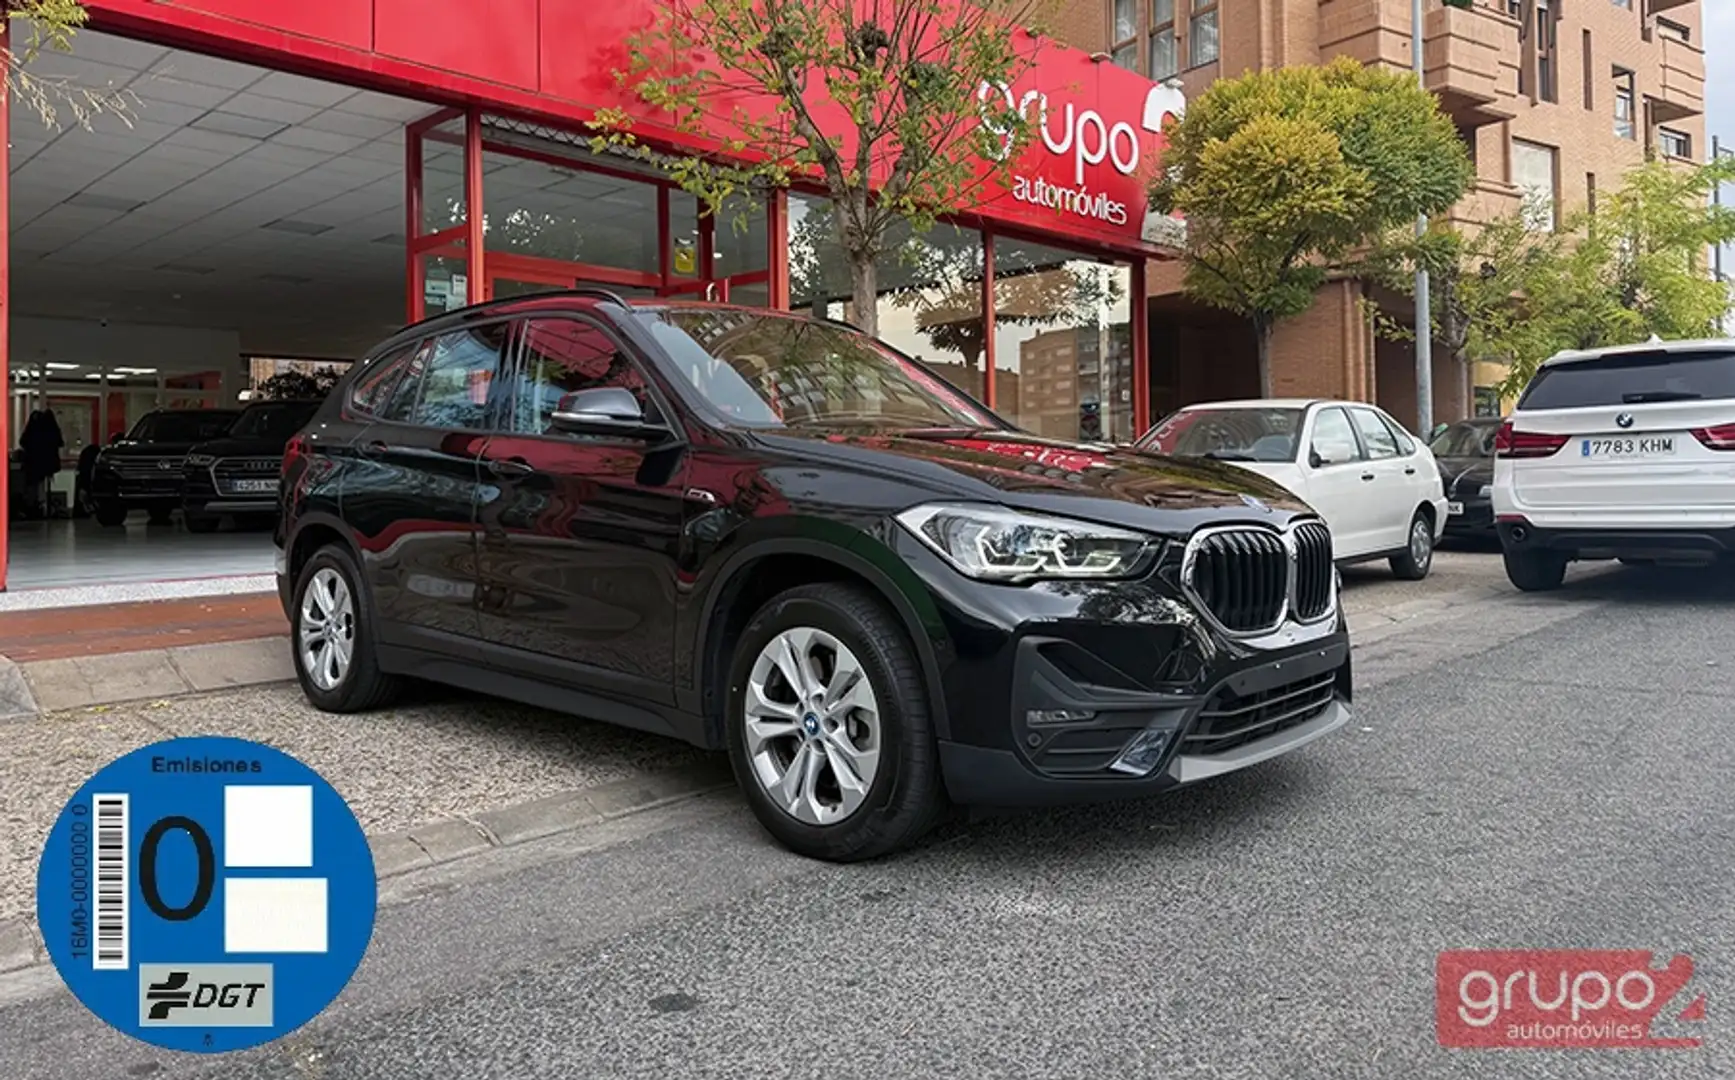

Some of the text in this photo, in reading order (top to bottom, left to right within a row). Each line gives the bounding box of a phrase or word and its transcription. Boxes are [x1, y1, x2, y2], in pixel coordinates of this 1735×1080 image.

[978, 80, 1139, 186] grupo
[1013, 175, 1127, 225] automóviles
[1592, 438, 1673, 455] 7783 KHM
